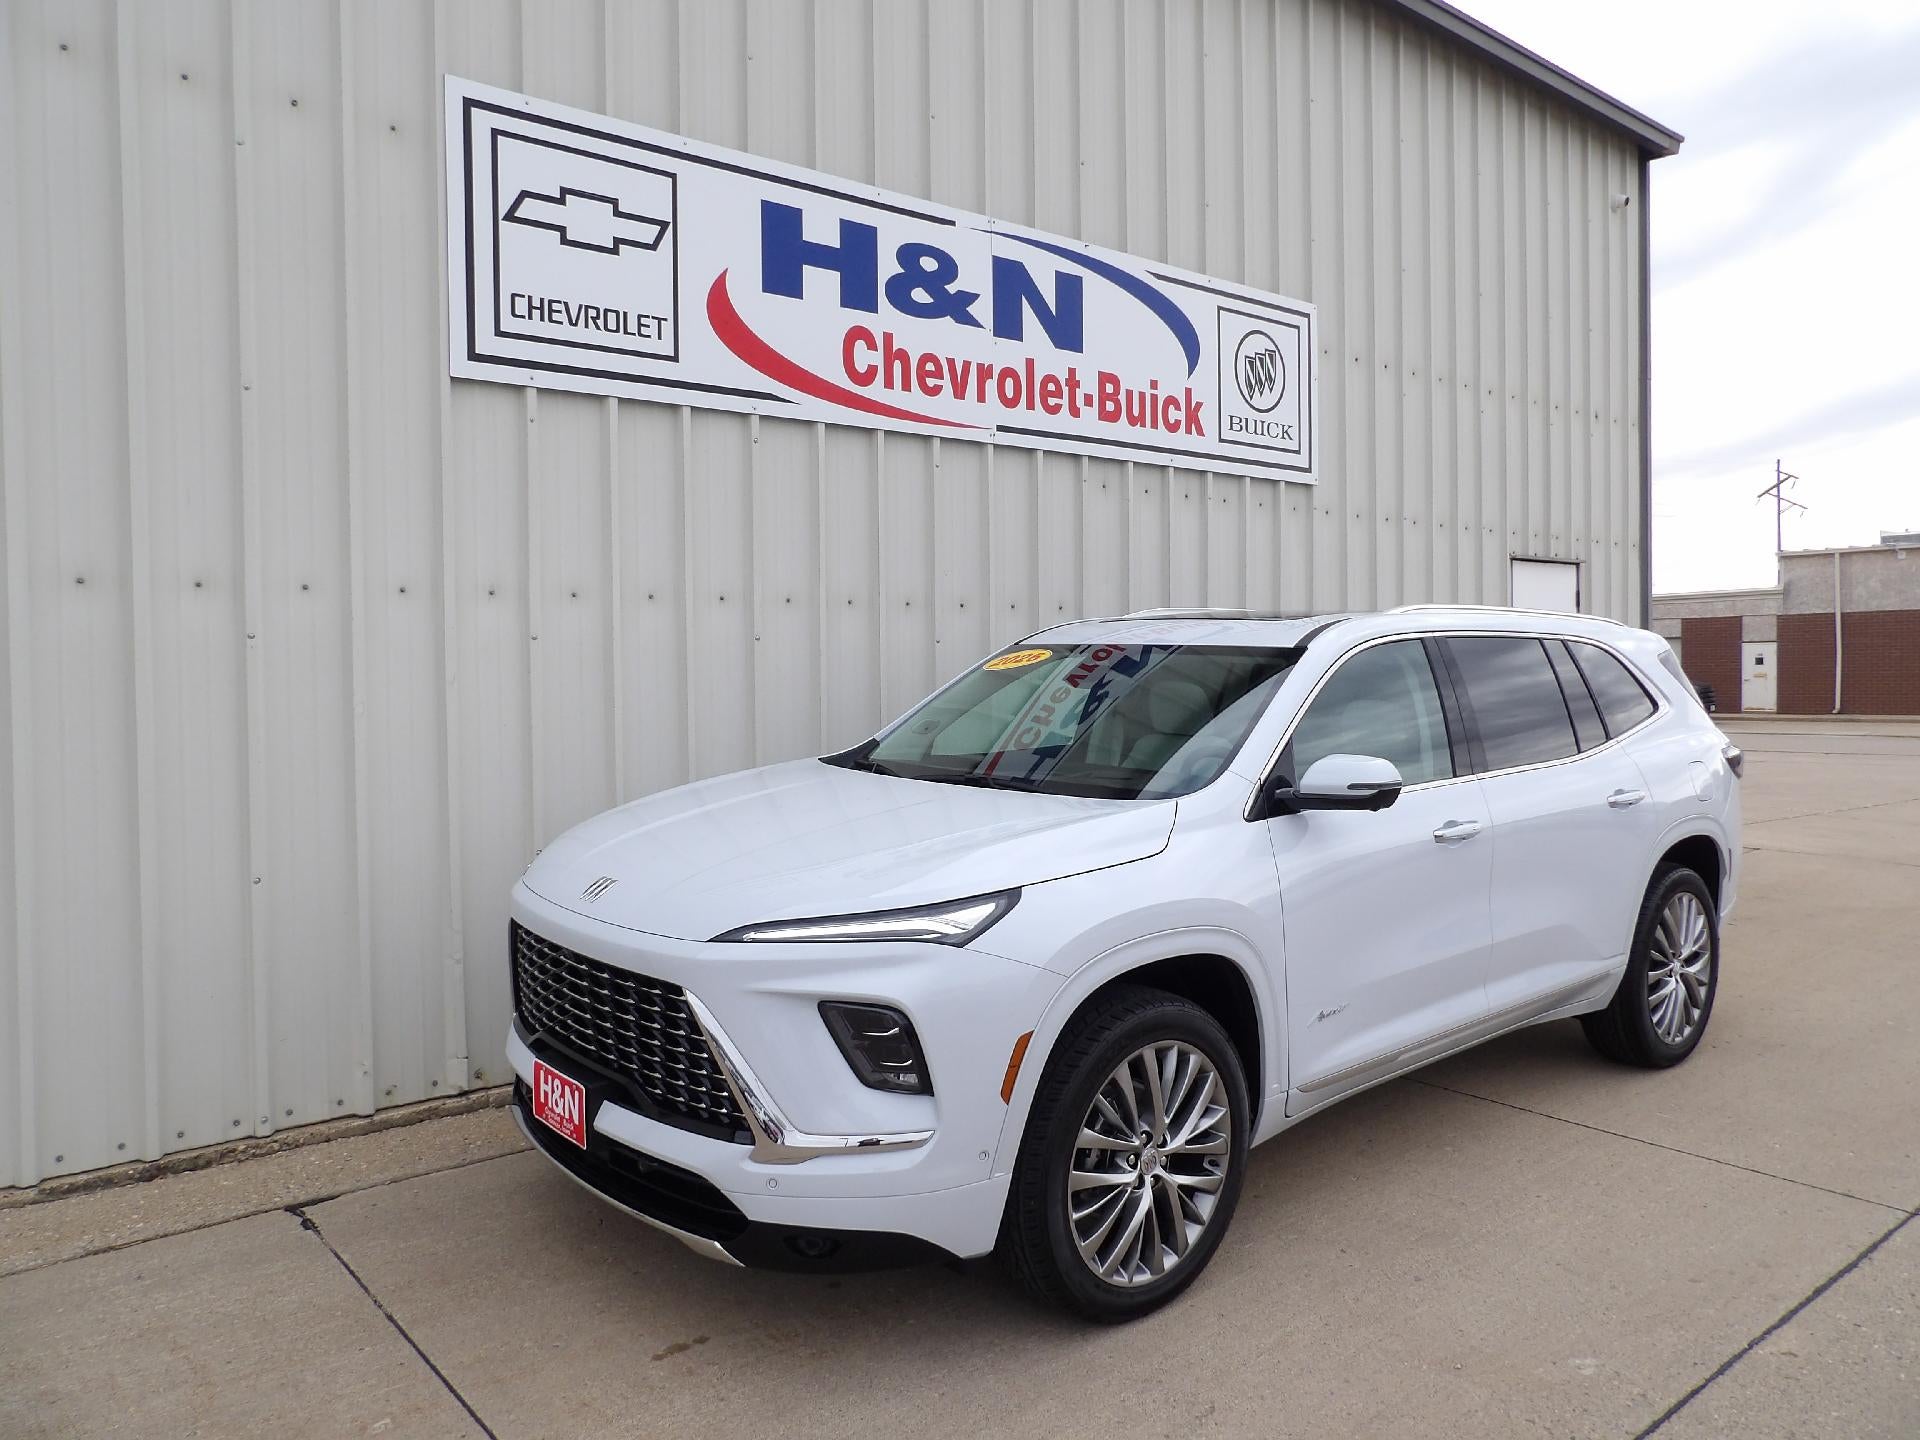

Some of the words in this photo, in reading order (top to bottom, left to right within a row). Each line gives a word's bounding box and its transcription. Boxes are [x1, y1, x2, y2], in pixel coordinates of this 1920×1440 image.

[761, 199, 1083, 354] H&N
[510, 292, 668, 341] CHEVROLET
[842, 324, 1206, 438] Chevrolet-Buick
[1227, 414, 1294, 441] BUICK
[540, 1069, 579, 1126] H&N
